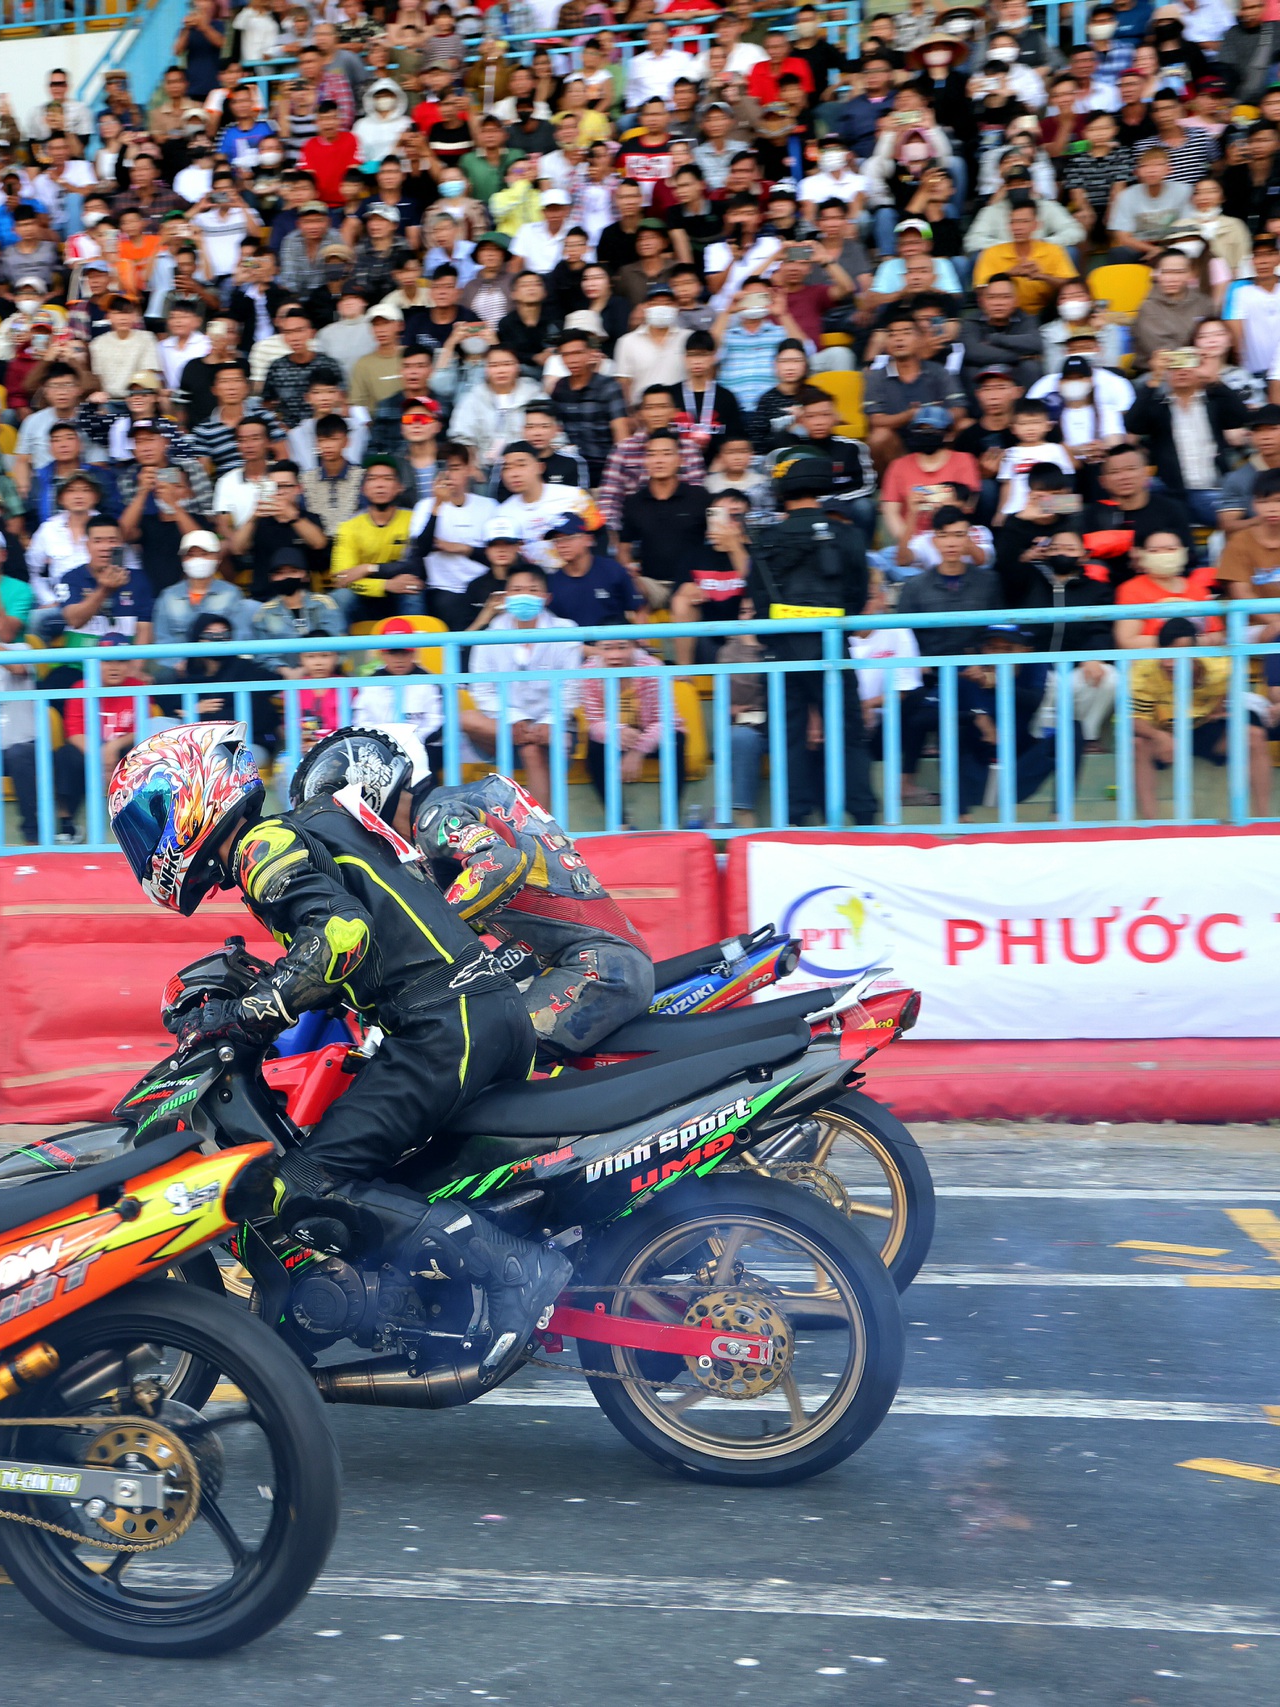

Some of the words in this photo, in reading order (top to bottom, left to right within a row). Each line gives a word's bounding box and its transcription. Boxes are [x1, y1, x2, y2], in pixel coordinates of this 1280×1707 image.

[158, 841, 185, 894] NHK
[800, 928, 852, 951] PT
[944, 896, 1246, 966] PHƯỚC
[660, 983, 716, 1015] UZUKI
[160, 1088, 199, 1116] PHAN
[658, 1097, 751, 1154] Sport
